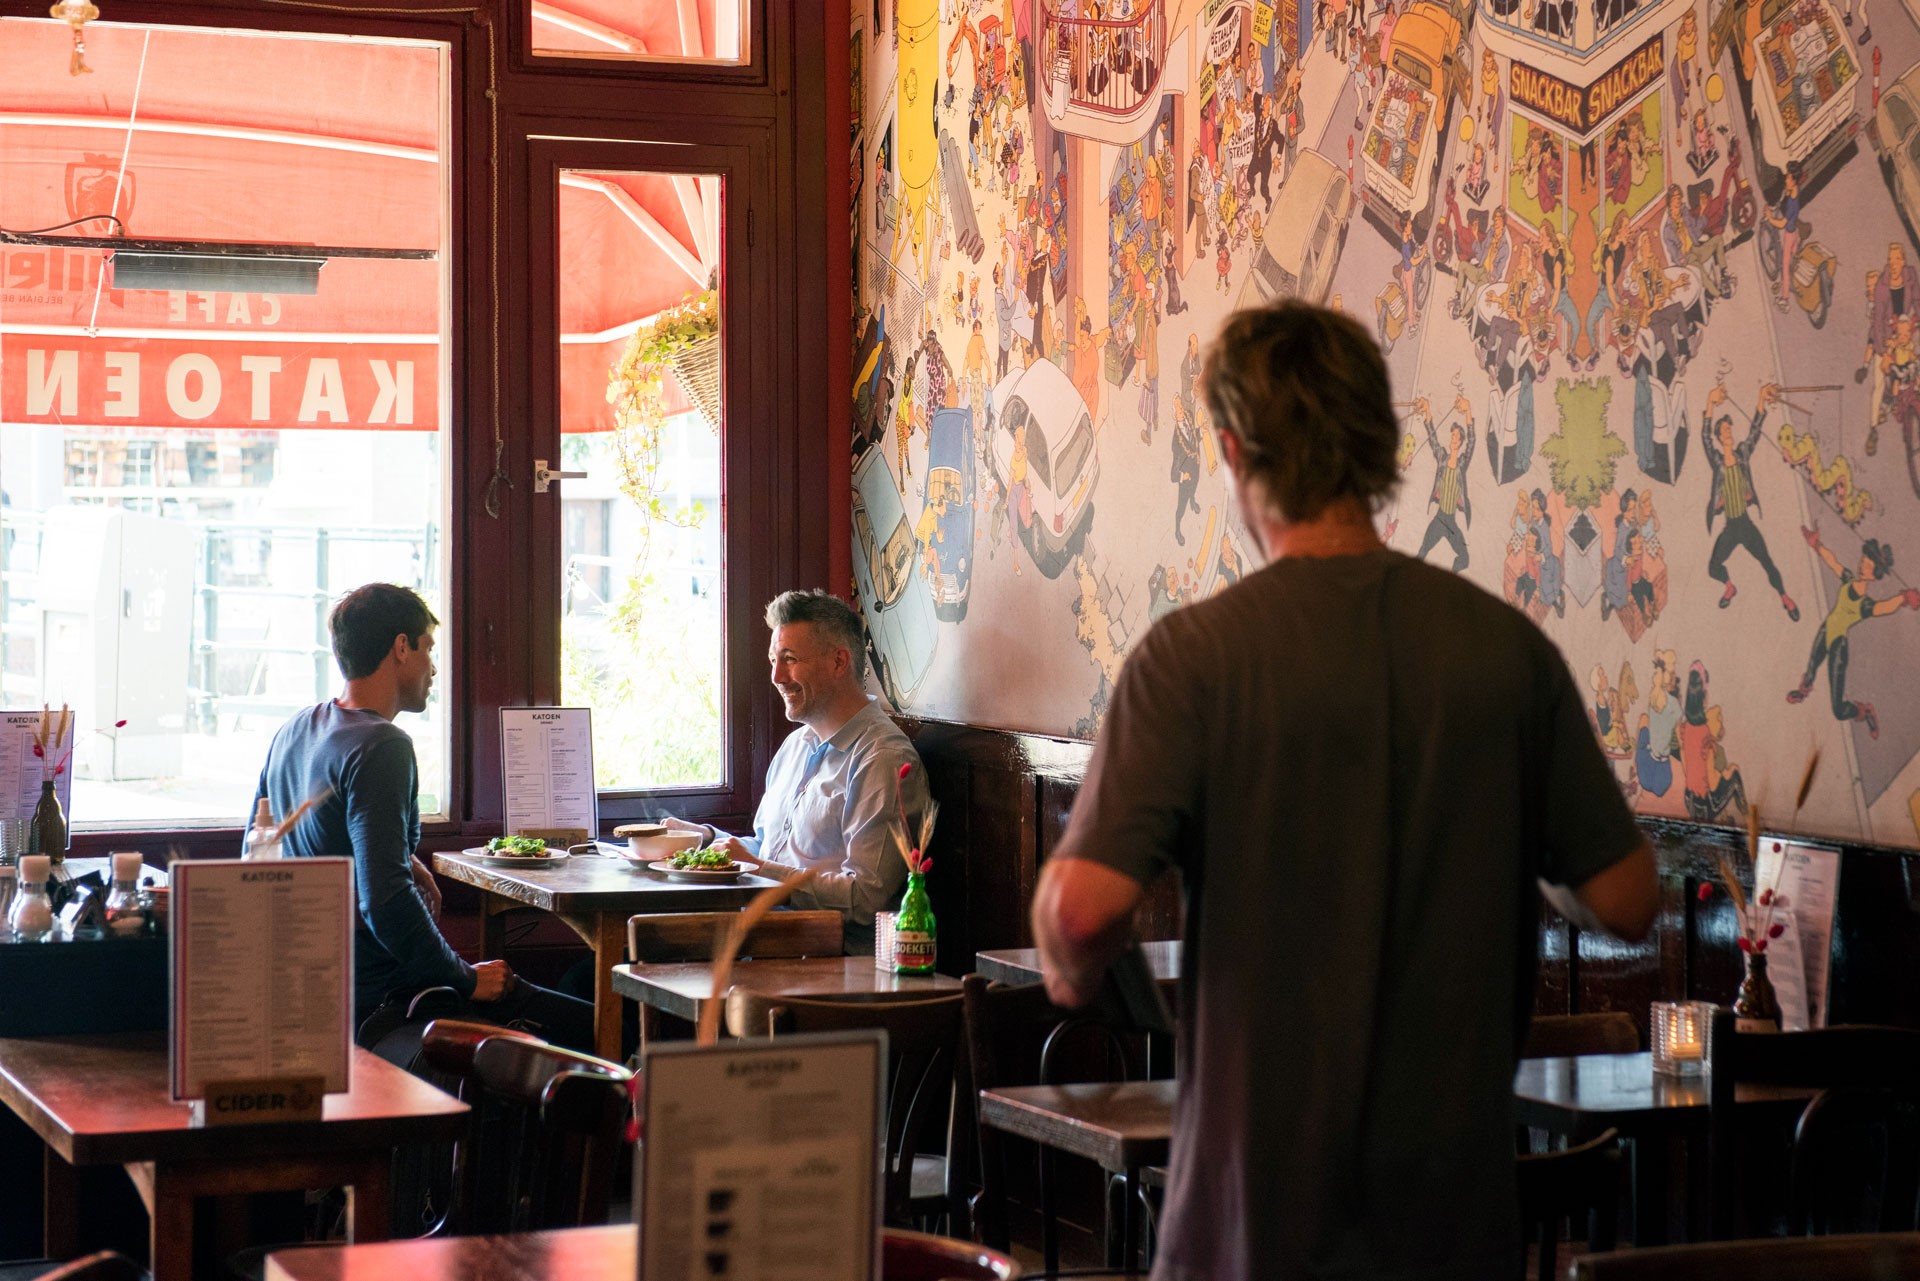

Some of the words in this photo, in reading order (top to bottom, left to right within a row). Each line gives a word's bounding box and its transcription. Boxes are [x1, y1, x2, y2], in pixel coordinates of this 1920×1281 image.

[1588, 39, 1663, 125] SNACKBAR
[1510, 63, 1583, 128] SNACKBAR
[544, 837, 566, 847] DER
[241, 871, 293, 882] KATOEN
[215, 1094, 286, 1113] CIDER
